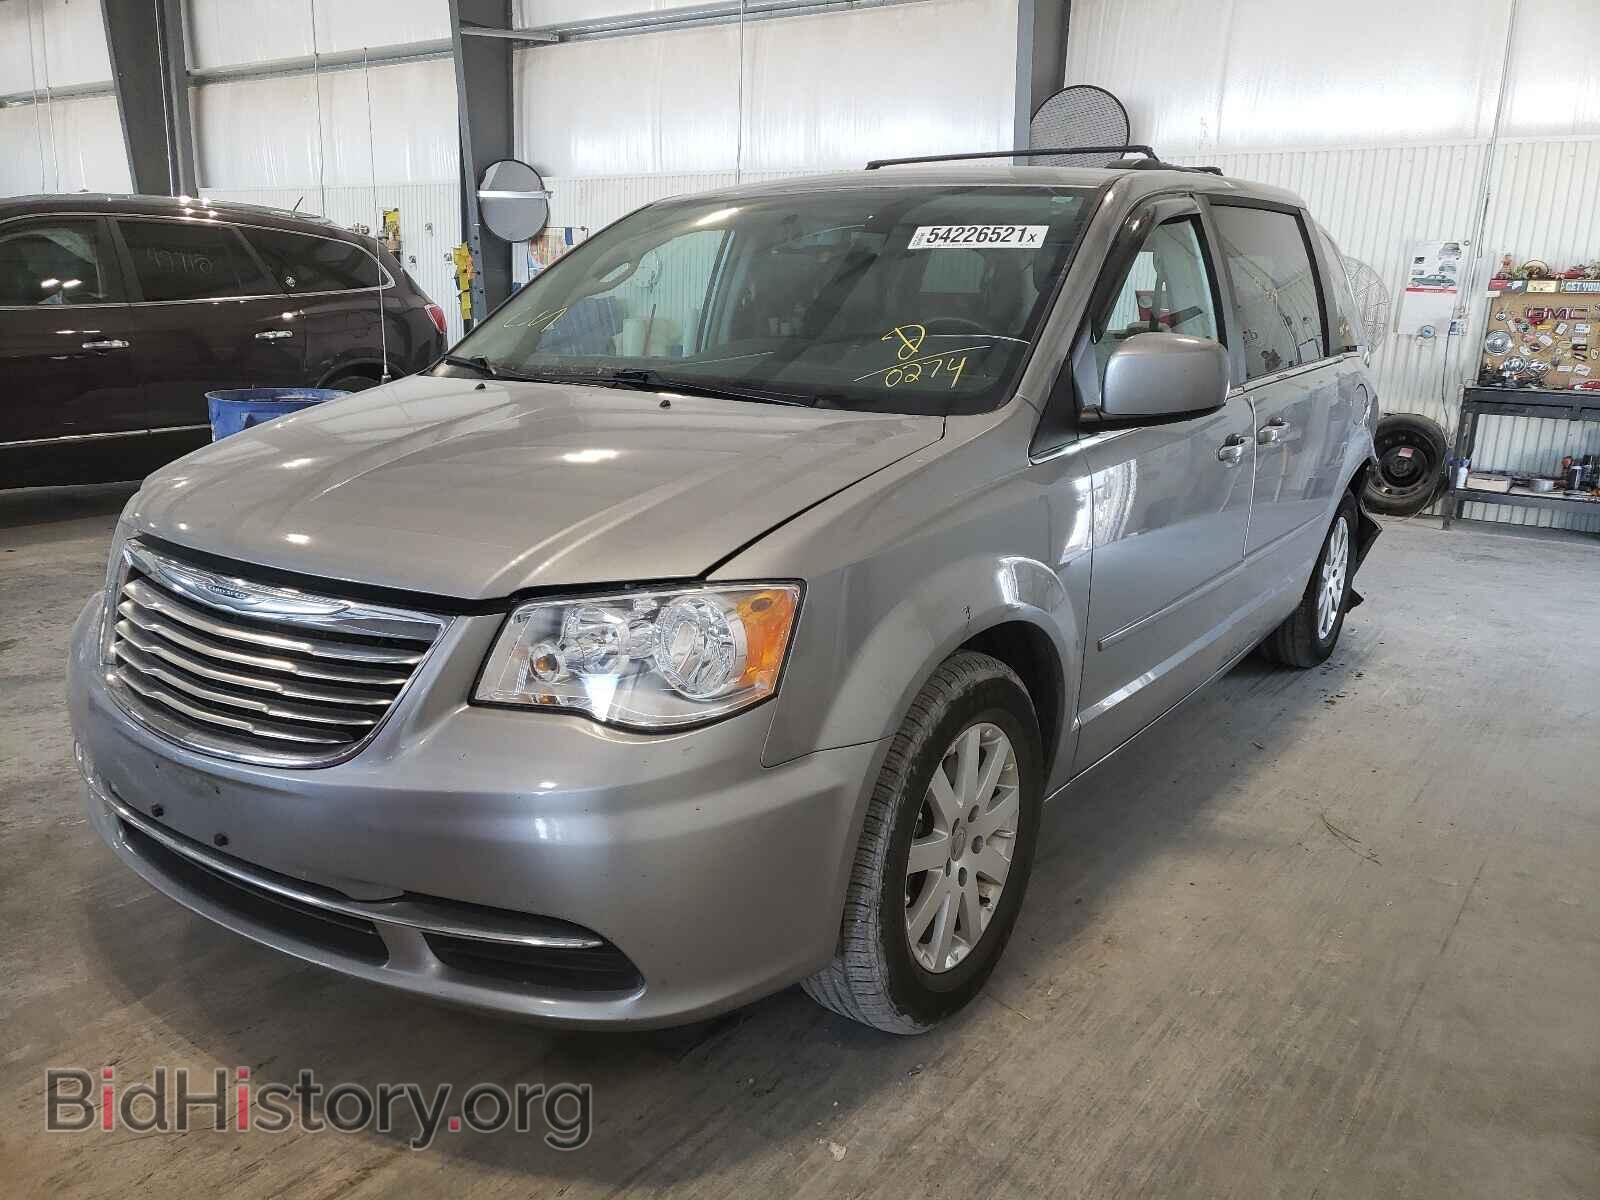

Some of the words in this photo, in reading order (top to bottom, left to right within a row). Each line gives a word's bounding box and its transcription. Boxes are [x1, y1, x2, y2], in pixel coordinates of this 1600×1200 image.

[926, 226, 1027, 243] 54226521
[1526, 306, 1587, 320] GMC
[885, 356, 967, 389] 0274
